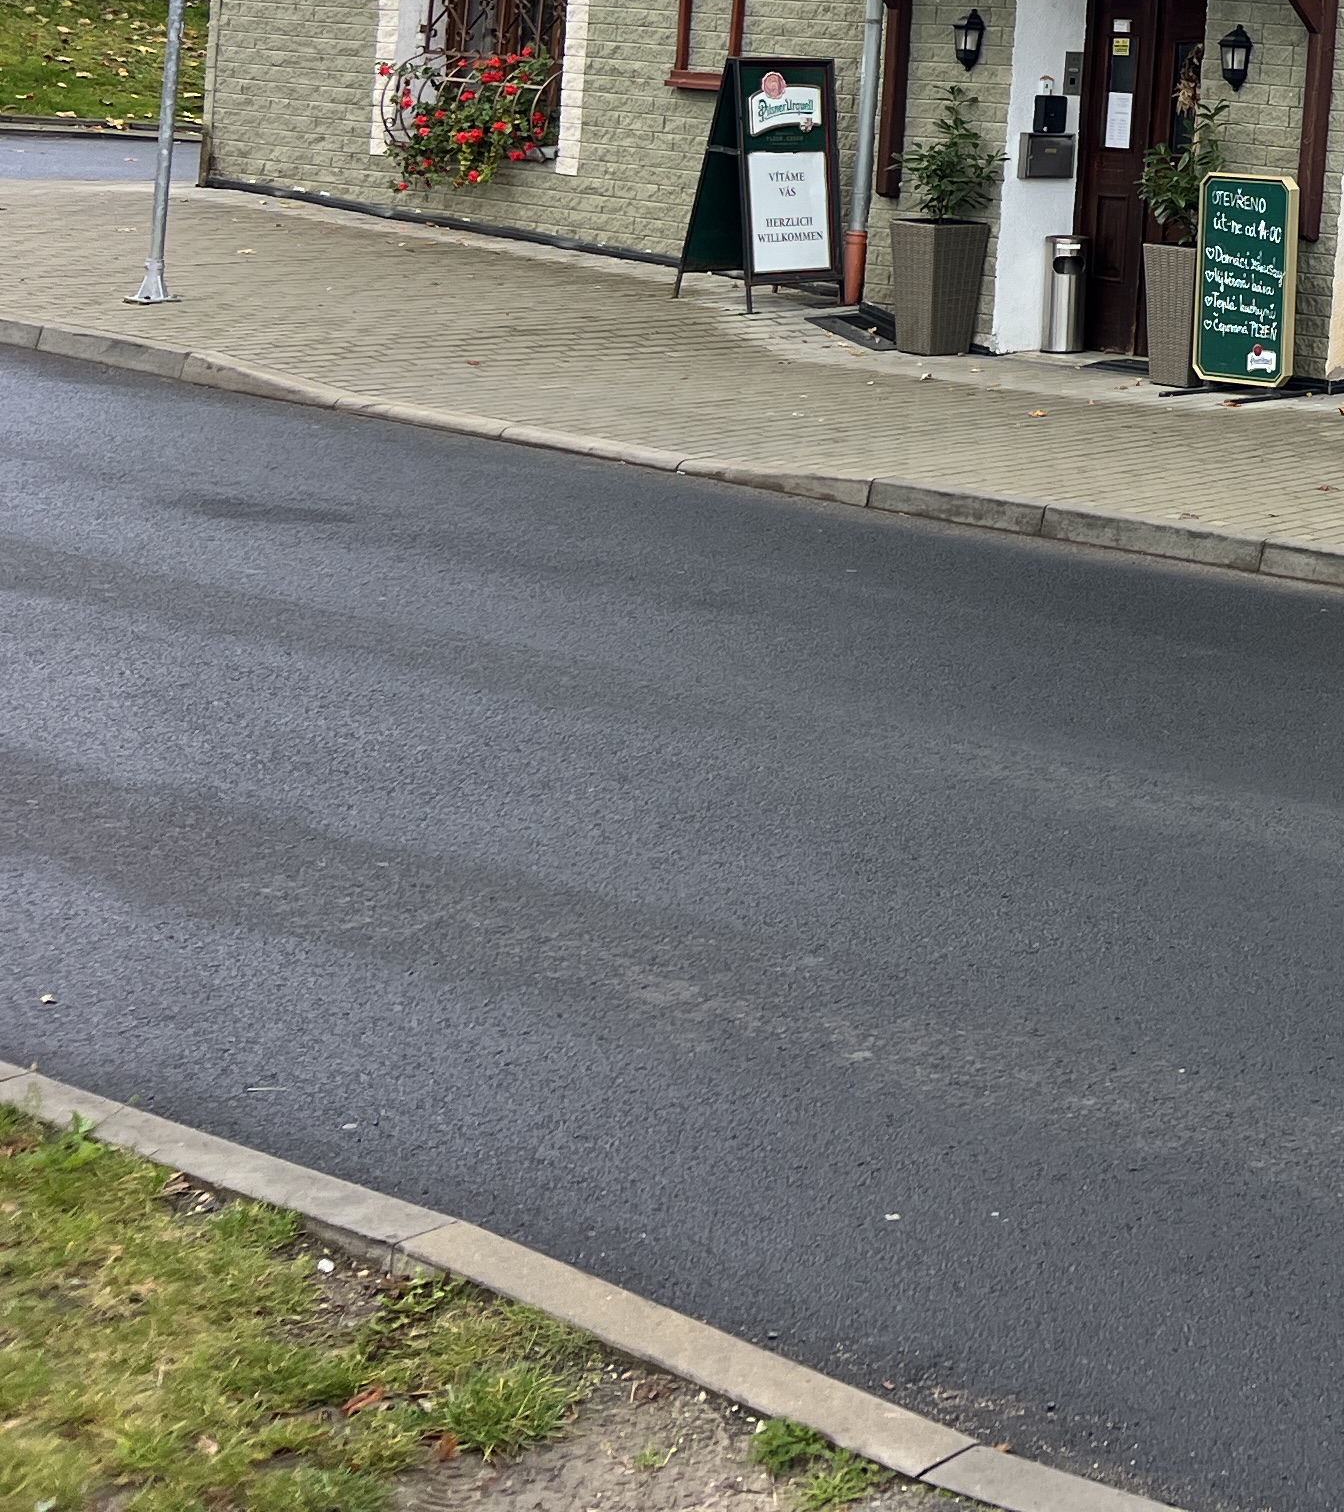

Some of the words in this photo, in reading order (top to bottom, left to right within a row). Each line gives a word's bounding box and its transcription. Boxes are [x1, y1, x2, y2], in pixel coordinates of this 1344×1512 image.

[758, 99, 786, 122] Pilsner
[785, 98, 814, 115] Urquell
[768, 170, 806, 182] VÍTÁME
[779, 185, 797, 197] VÁS
[1212, 188, 1267, 214] OTEVŘENO
[766, 217, 813, 228] HERZLICH
[1245, 222, 1257, 238] od
[757, 231, 824, 243] WILLKOMMEN
